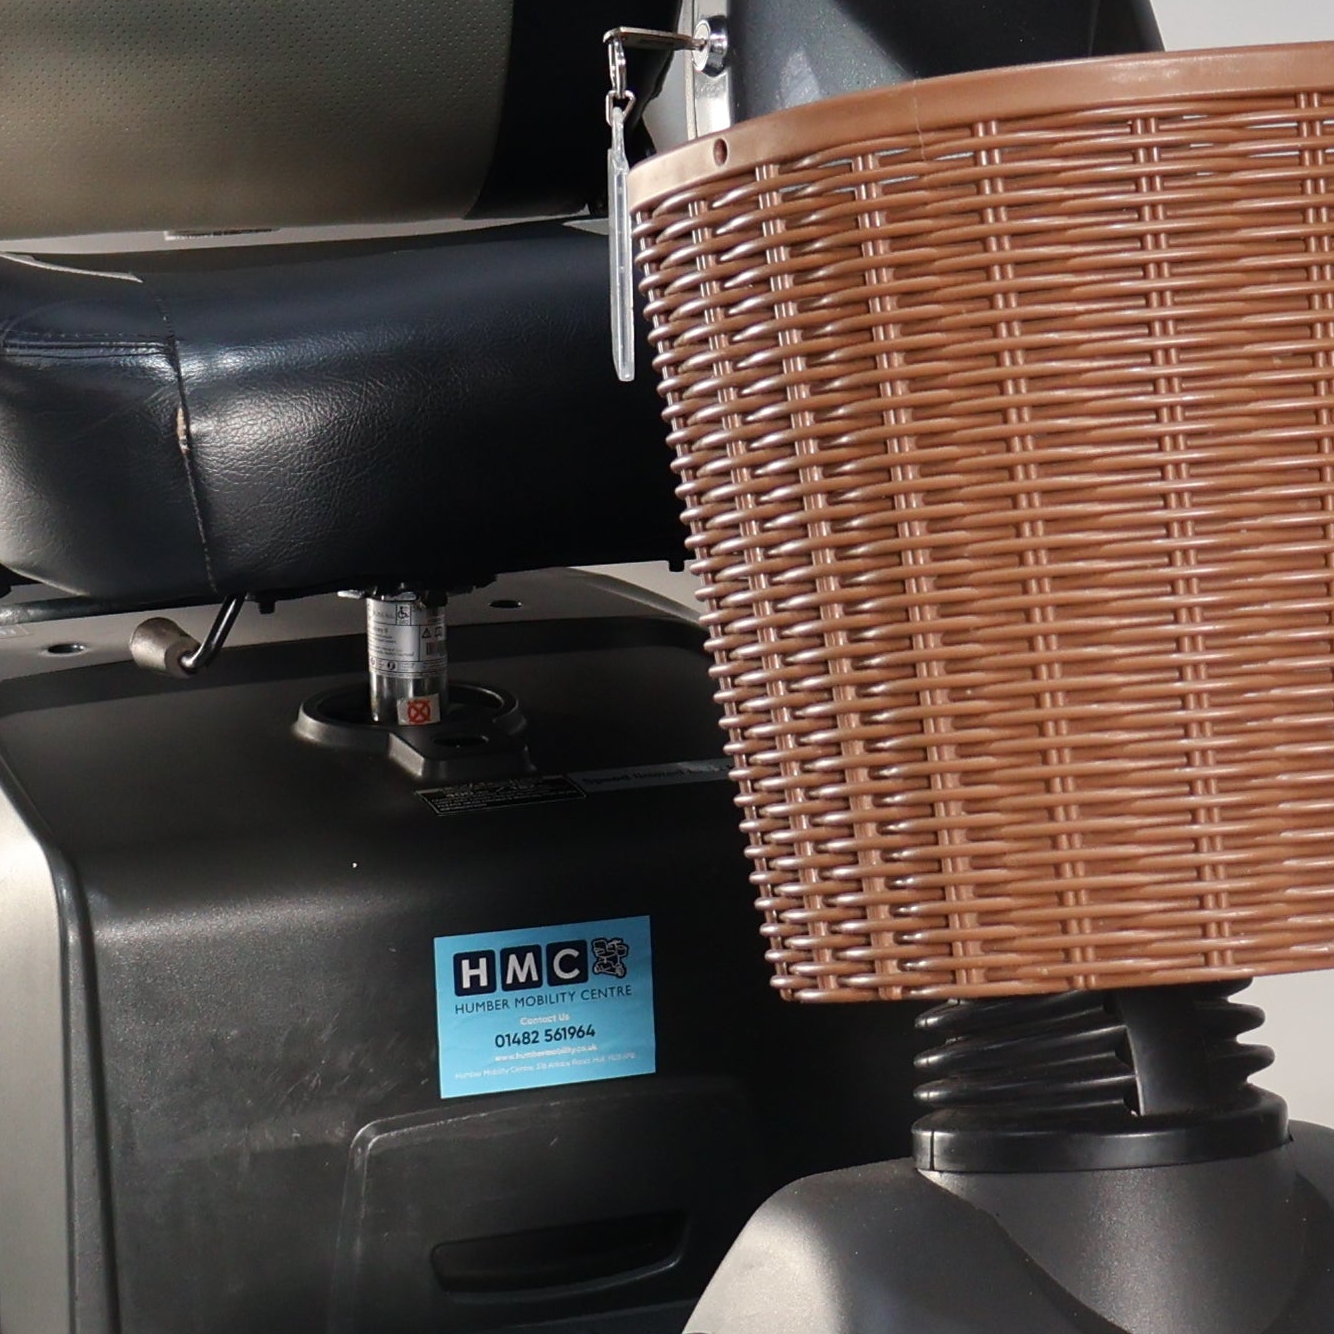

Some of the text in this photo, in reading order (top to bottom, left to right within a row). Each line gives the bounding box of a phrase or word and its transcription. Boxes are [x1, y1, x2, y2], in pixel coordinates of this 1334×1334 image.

[460, 947, 581, 990] HMC
[455, 984, 633, 1014] HUMBER MOBILITY CENTRE
[520, 1012, 570, 1025] Contact Us
[495, 1023, 596, 1048] 01482 561964
